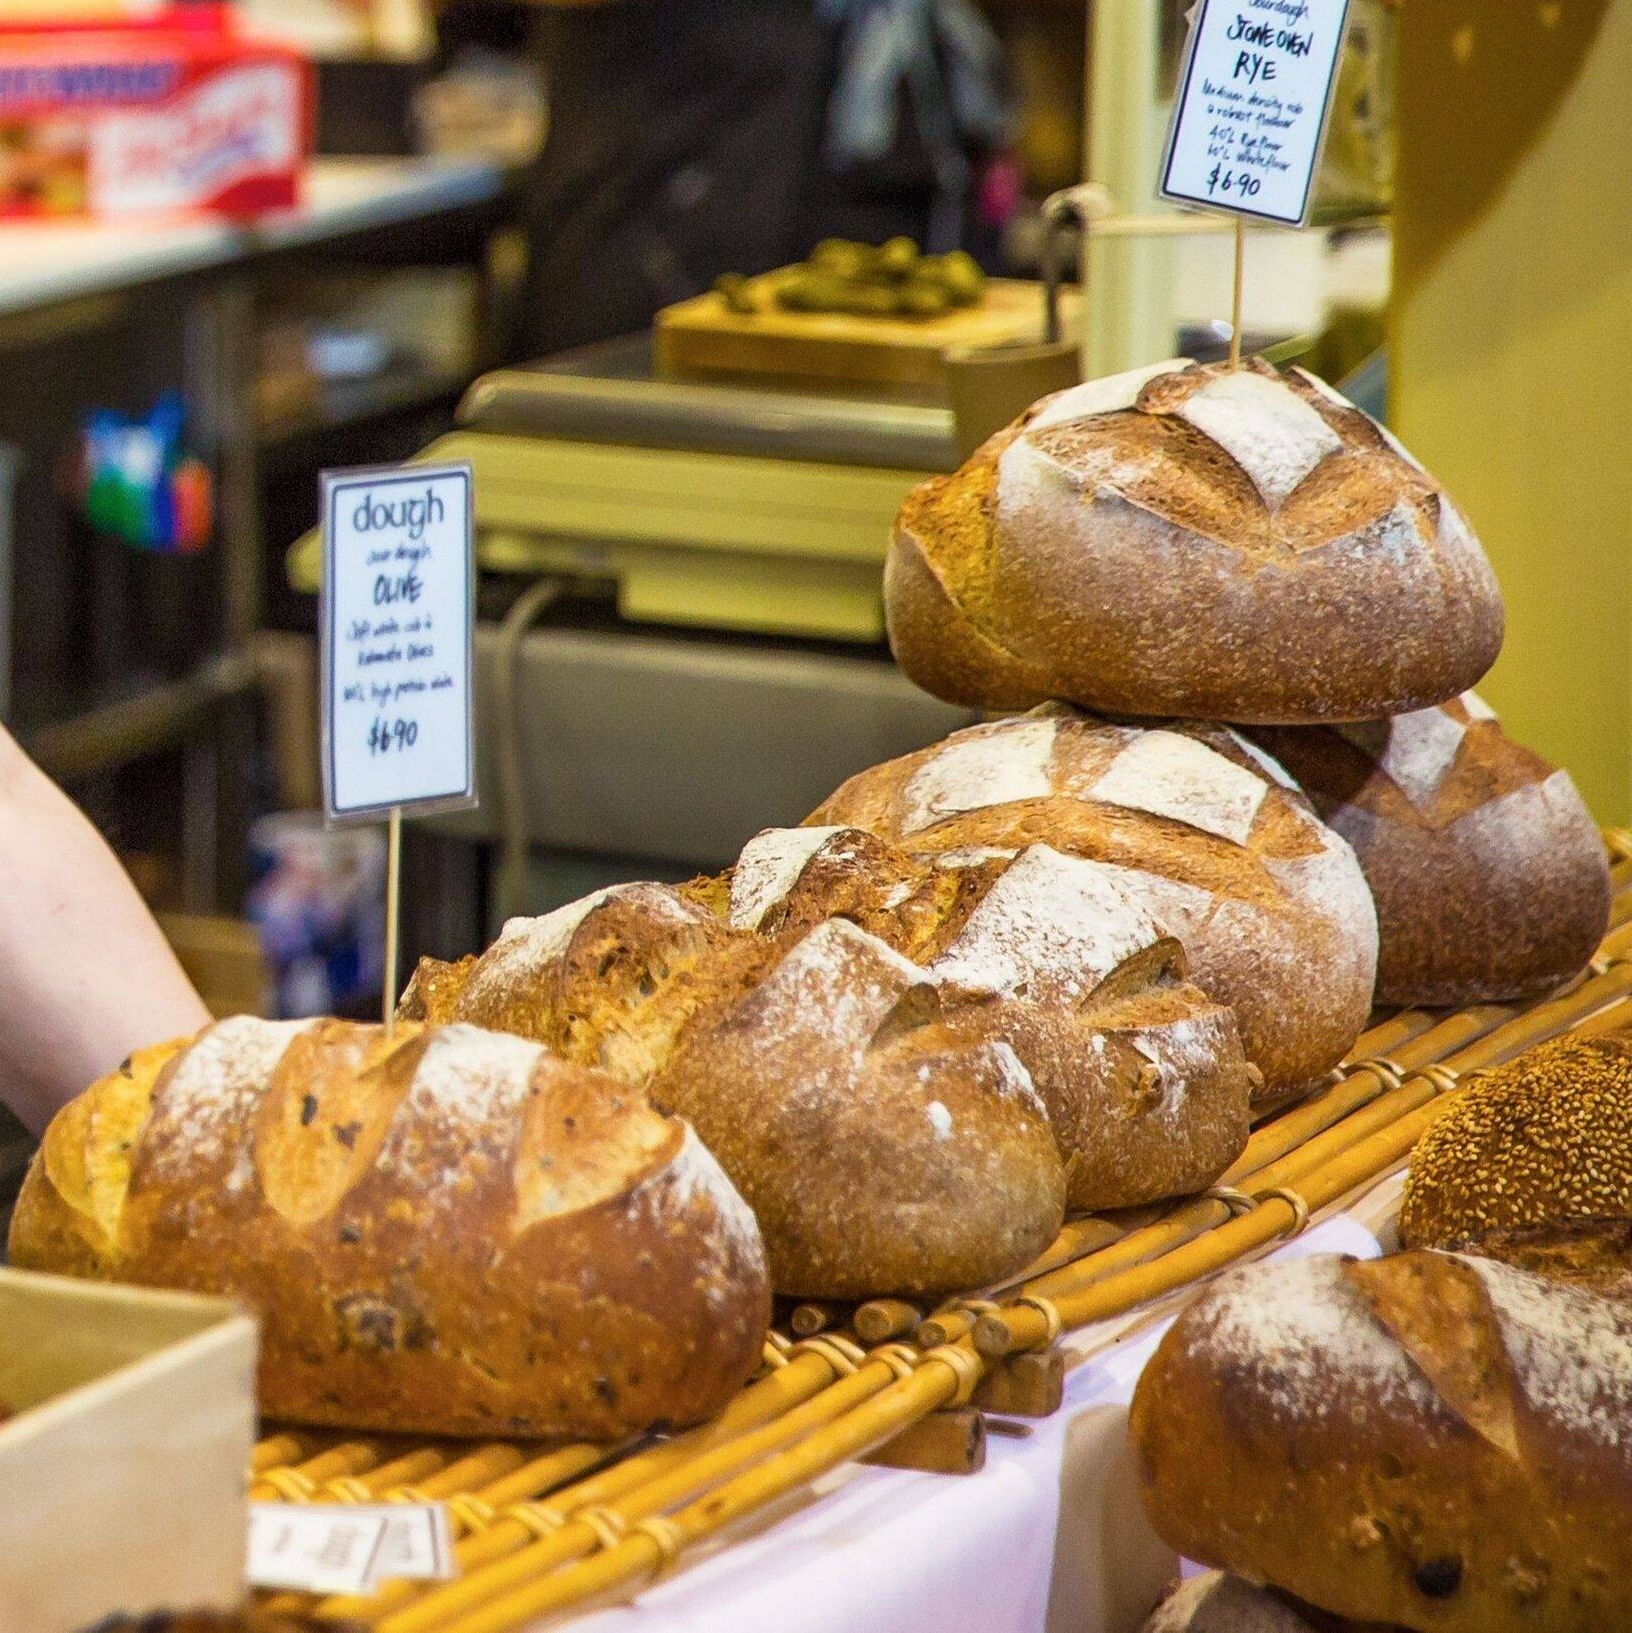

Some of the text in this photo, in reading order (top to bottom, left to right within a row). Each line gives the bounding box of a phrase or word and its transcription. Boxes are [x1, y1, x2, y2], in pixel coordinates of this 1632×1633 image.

[1226, 14, 1314, 58] STONE OVEN
[1233, 50, 1277, 84] RYE
[1206, 162, 1261, 196] $6.90
[353, 487, 445, 539] dough
[374, 574, 424, 606] OLIVE
